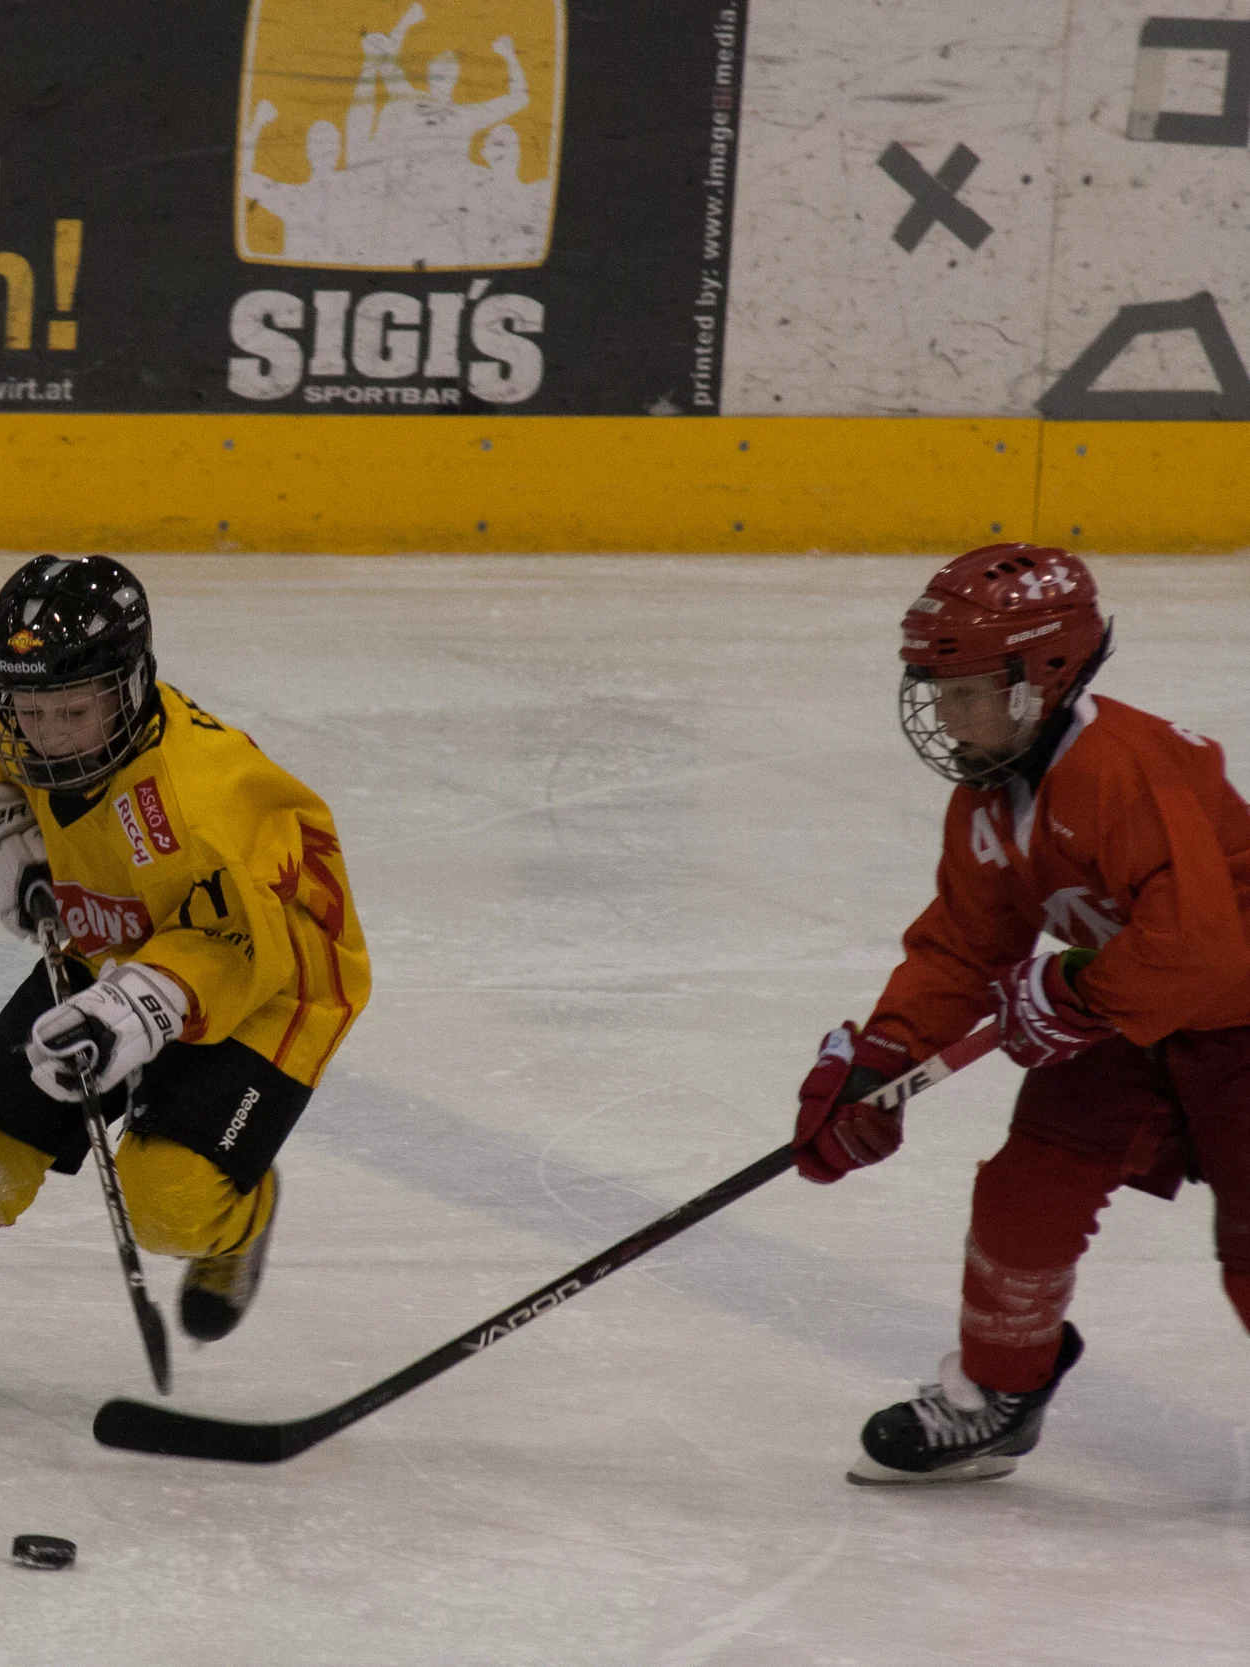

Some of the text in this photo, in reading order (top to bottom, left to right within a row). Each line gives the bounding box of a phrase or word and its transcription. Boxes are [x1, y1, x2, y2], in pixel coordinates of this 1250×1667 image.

[691, 315, 716, 406] printed
[303, 385, 462, 405] SPORTBAR
[1005, 621, 1063, 646] BAUER
[0, 659, 47, 675] Reebok
[138, 786, 166, 829] ASKÖ
[54, 895, 144, 945] elly's
[218, 1086, 261, 1152] Reebok
[460, 1278, 587, 1351] VAPOR
